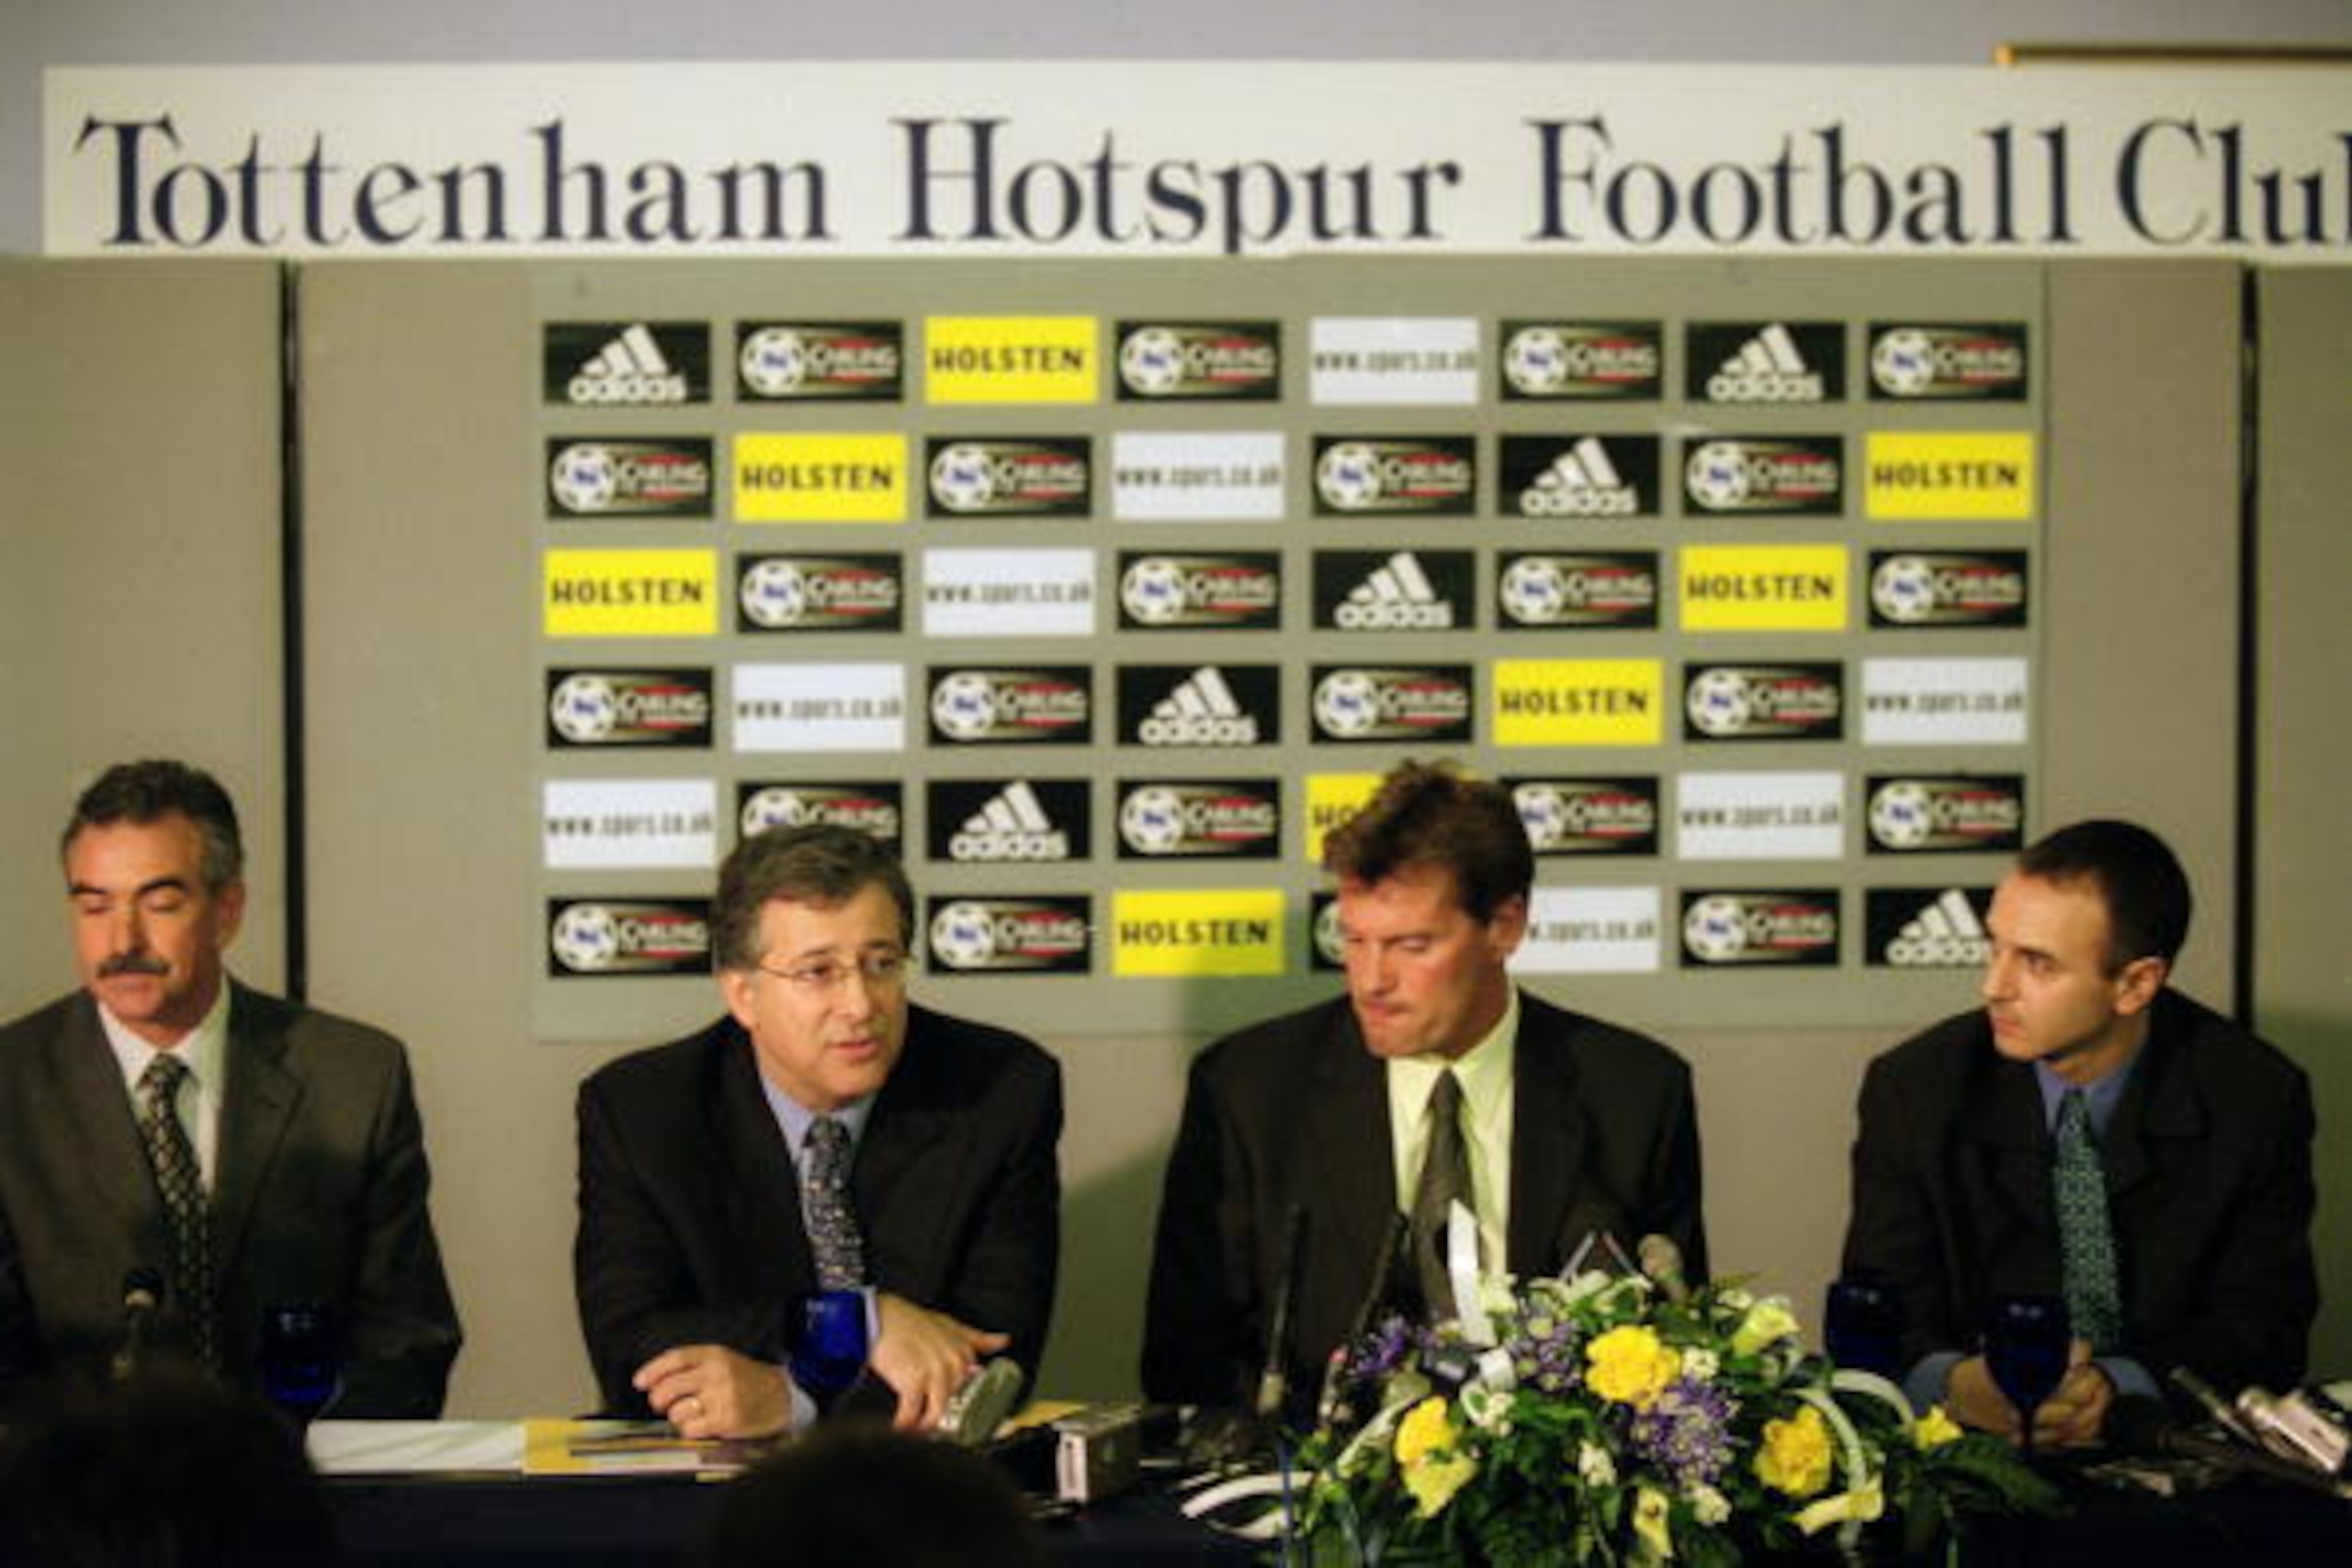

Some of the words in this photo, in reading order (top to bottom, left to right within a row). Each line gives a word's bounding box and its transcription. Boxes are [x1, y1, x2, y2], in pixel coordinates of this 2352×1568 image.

[73, 112, 838, 247] Tottenham
[888, 116, 1463, 254] Hotspur
[1521, 114, 2080, 245] Football
[2114, 116, 2352, 246] Clu
[932, 346, 1084, 372] HOLSTEN
[568, 373, 690, 401] adidas
[1707, 372, 1824, 401] adidas
[741, 463, 893, 490] HOLSTEN
[1872, 462, 2019, 488] HOLSTEN
[1521, 485, 1638, 515] adidas
[551, 578, 703, 604] HOLSTEN
[1686, 574, 1834, 600] HOLSTEN
[1336, 600, 1453, 628] adidas
[1499, 688, 1649, 715] HOLSTEN
[1139, 716, 1258, 745] adidas
[949, 830, 1069, 861] adidas
[1120, 919, 1271, 946] HOLSTEN
